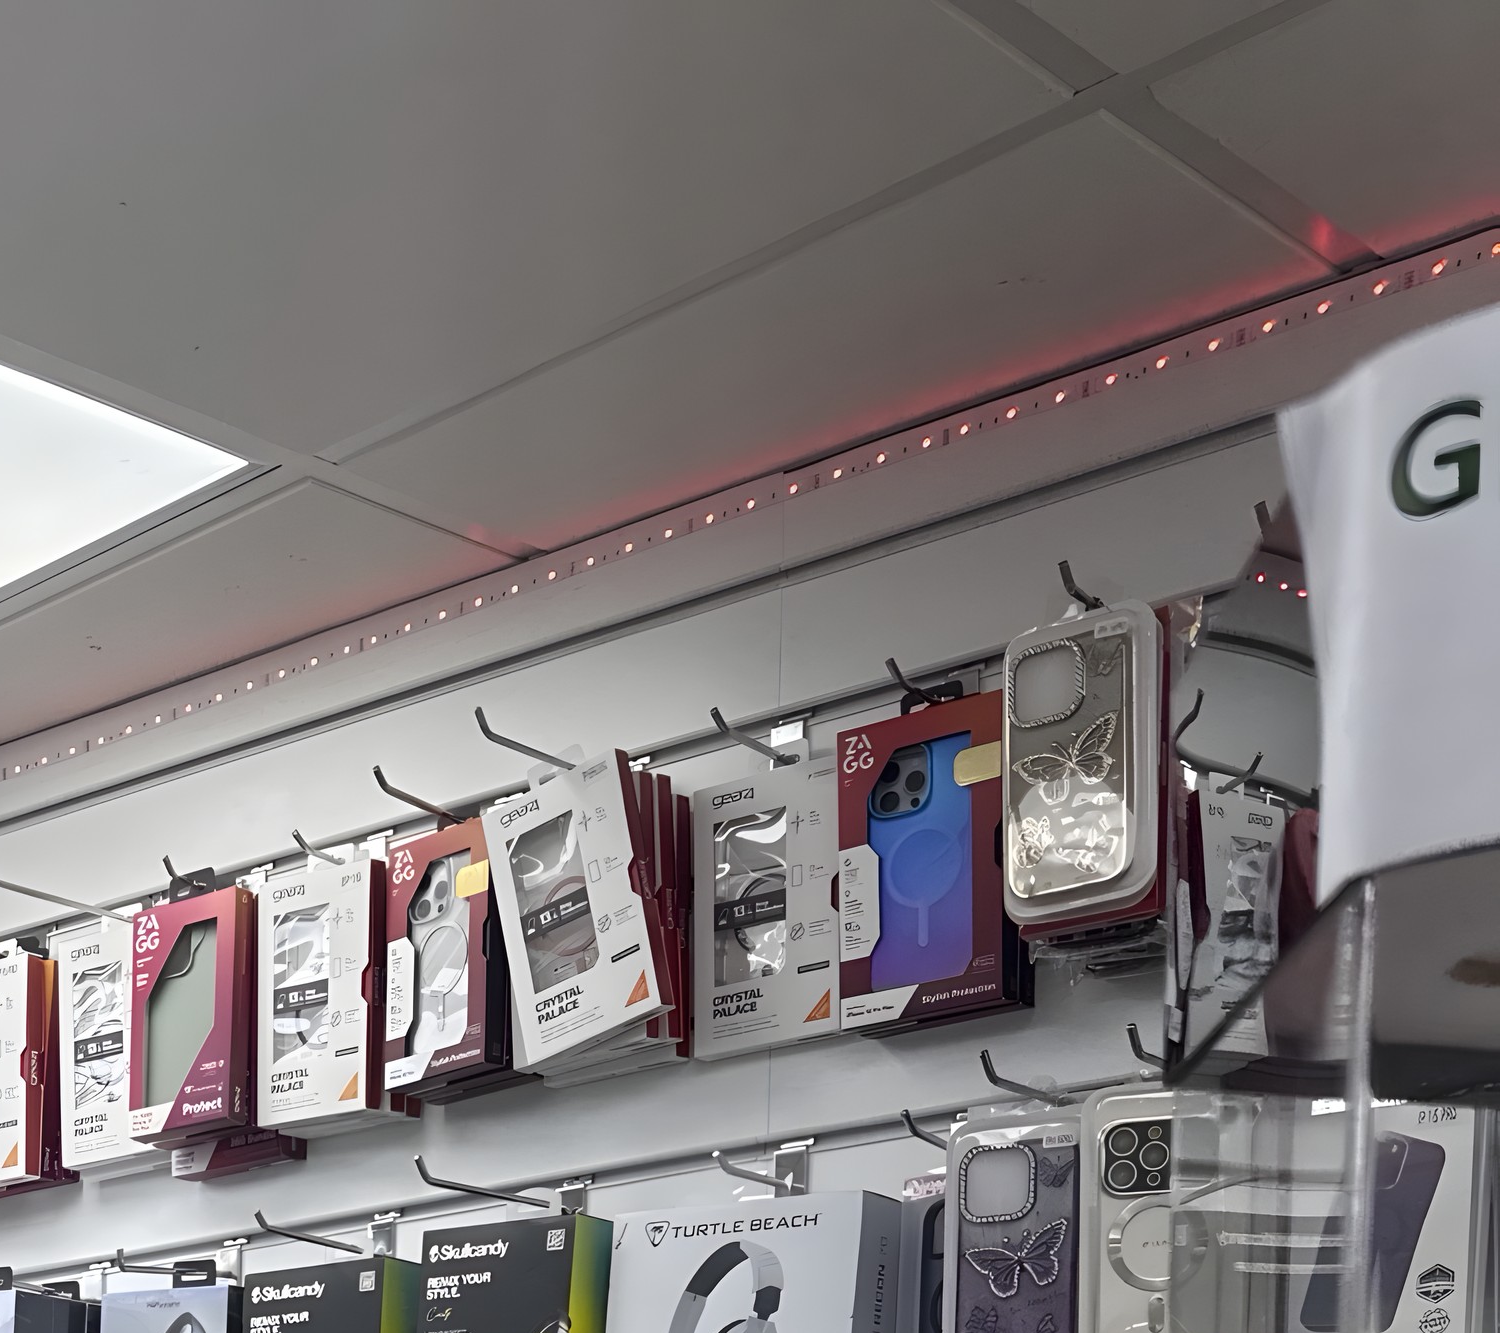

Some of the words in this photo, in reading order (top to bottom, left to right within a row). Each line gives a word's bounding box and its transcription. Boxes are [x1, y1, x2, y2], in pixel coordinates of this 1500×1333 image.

[1390, 399, 1481, 521] G
[672, 1219, 744, 1239] TURTLE
[750, 1213, 820, 1232] BEACH
[440, 1239, 509, 1262] Skullcandy
[462, 1272, 491, 1285] YOUR
[262, 1281, 325, 1303] Skullcandy
